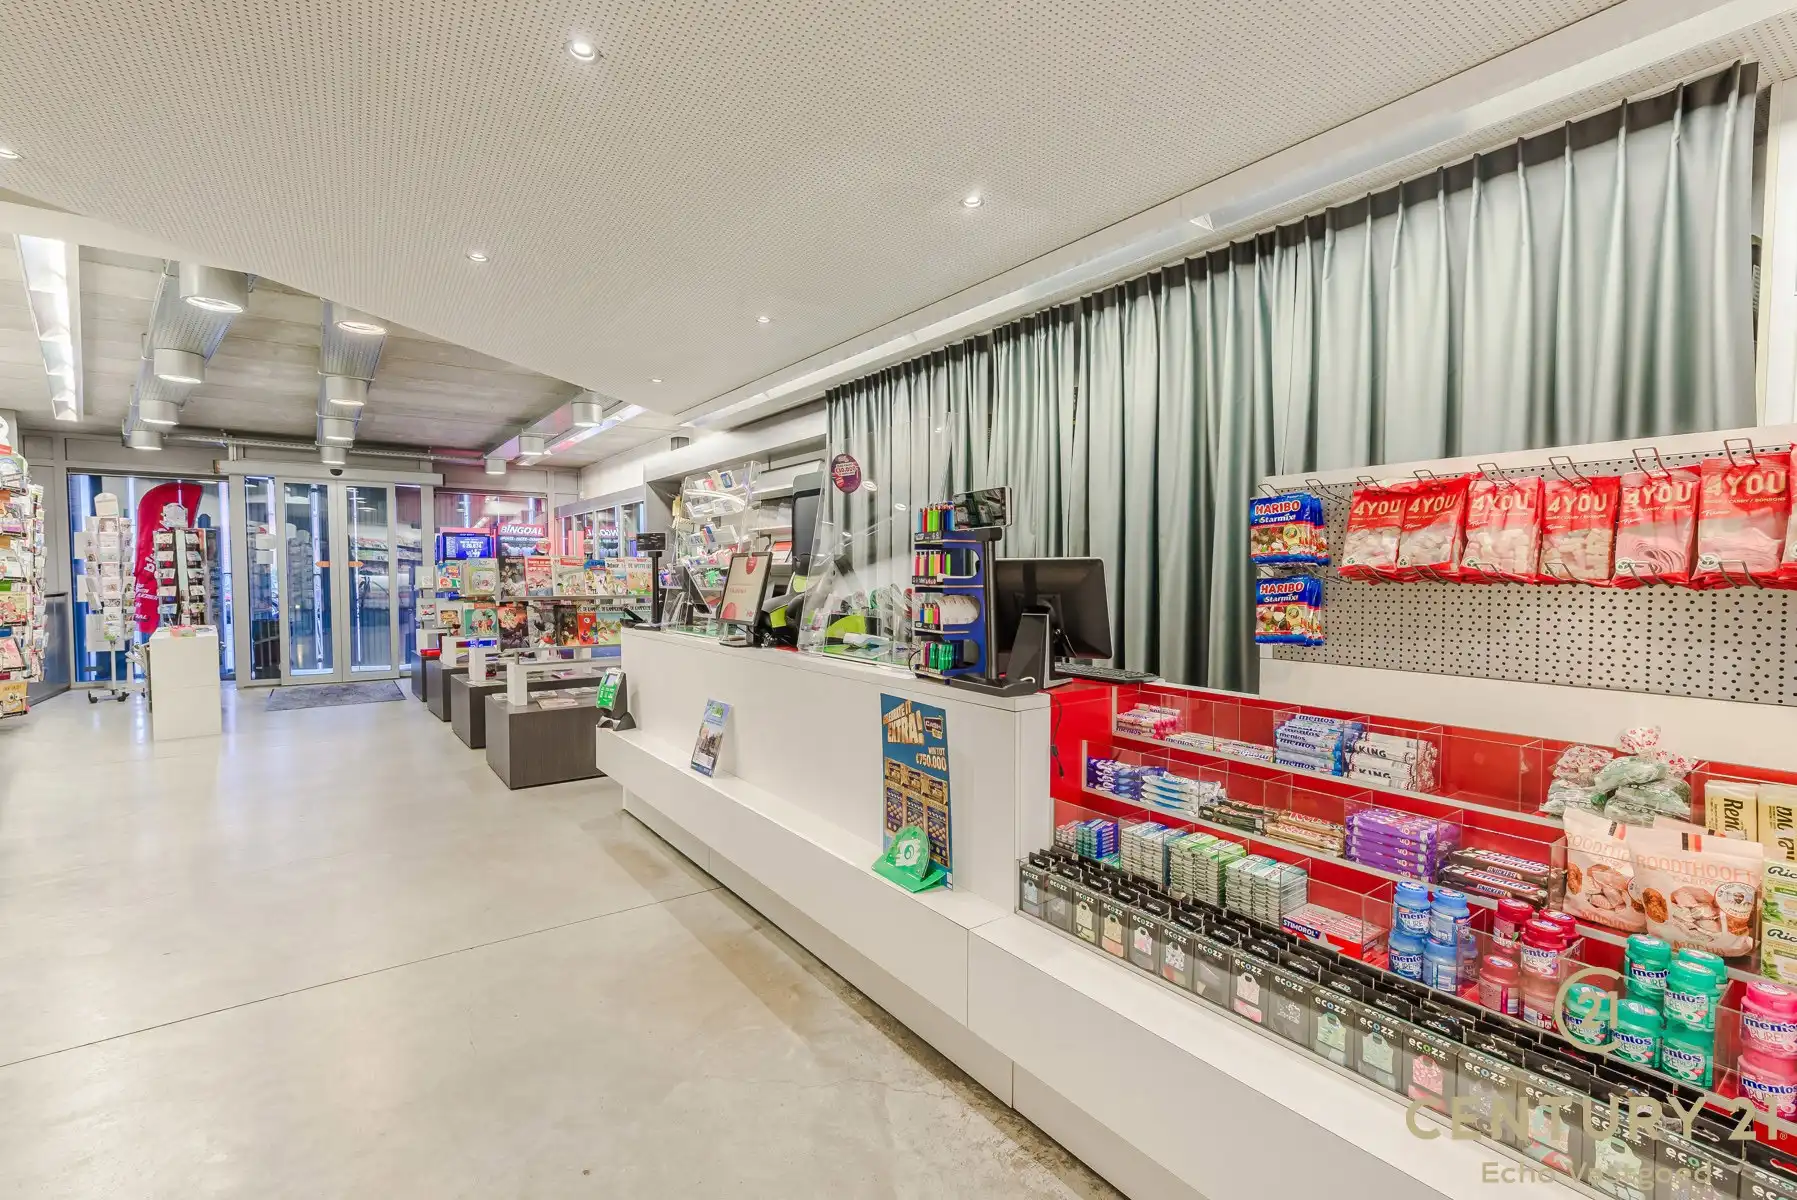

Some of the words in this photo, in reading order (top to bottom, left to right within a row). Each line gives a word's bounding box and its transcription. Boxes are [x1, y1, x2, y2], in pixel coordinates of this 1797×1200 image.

[1703, 470, 1787, 498] 4YOU
[1471, 491, 1529, 511] 4YOU
[1623, 482, 1692, 506] 4YOU
[1255, 500, 1301, 516] HARIBO
[1353, 500, 1400, 516] 4YOU
[1408, 494, 1456, 514] 4YOU
[1547, 494, 1607, 513] 4YOU
[1260, 582, 1304, 595] HARIBO
[1298, 715, 1336, 725] mentos
[1279, 738, 1317, 750] mentos
[1358, 745, 1388, 758] KING
[1279, 759, 1317, 771] mentos
[1358, 768, 1392, 780] KING
[1488, 867, 1516, 879] SNICKERS
[1636, 855, 1758, 885] ROODTHOOFT
[1075, 891, 1094, 904] ecozz
[1478, 884, 1506, 896] SNICKERS
[1132, 915, 1154, 929] ecozz
[1164, 928, 1187, 944] ecozz
[1198, 943, 1223, 960] ecozz
[1234, 958, 1263, 975] ecozz
[1274, 975, 1304, 993] ecozz
[1315, 996, 1347, 1016] ecozz
[1359, 1017, 1395, 1038] ecozz
[1408, 1037, 1446, 1059] ecozz
[1464, 1061, 1506, 1085] ecozz
